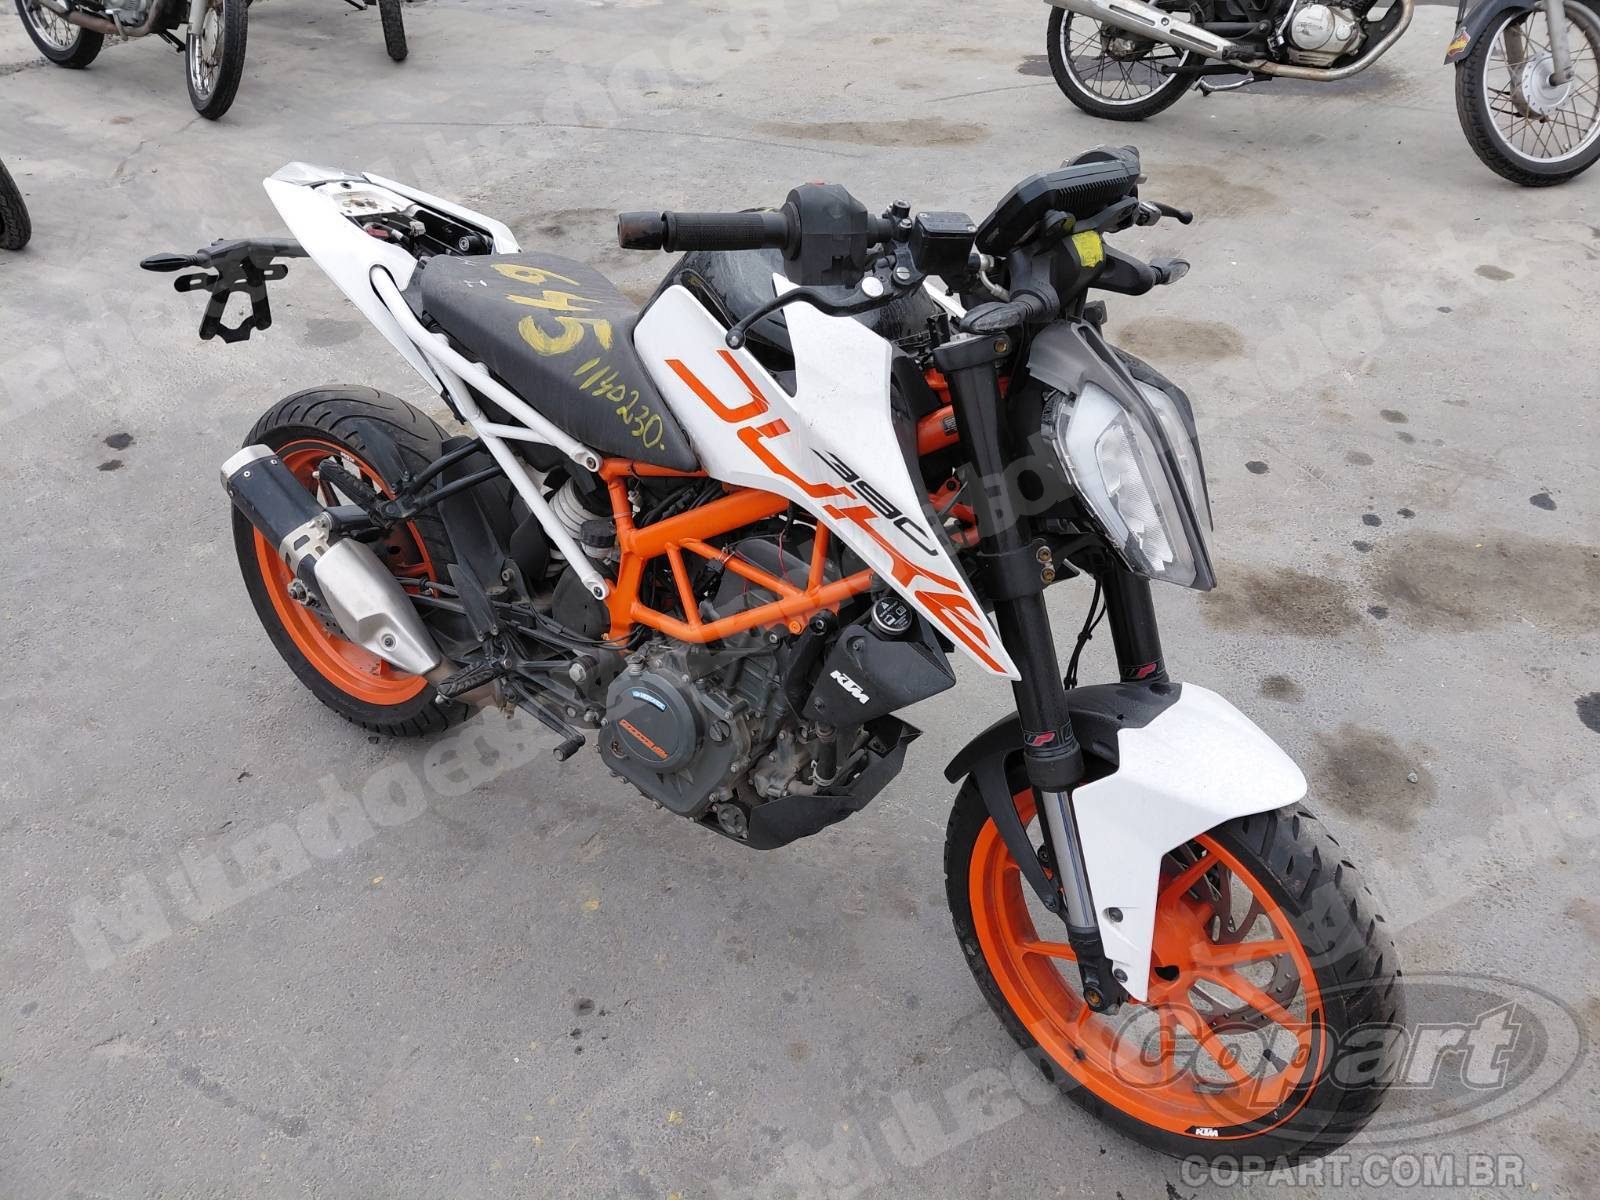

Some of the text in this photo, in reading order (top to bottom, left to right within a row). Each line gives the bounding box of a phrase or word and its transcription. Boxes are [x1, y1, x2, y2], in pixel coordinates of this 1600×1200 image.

[663, 349, 1008, 674] DUKE
[829, 669, 870, 705] KTM
[1195, 1127, 1220, 1138] KTM
